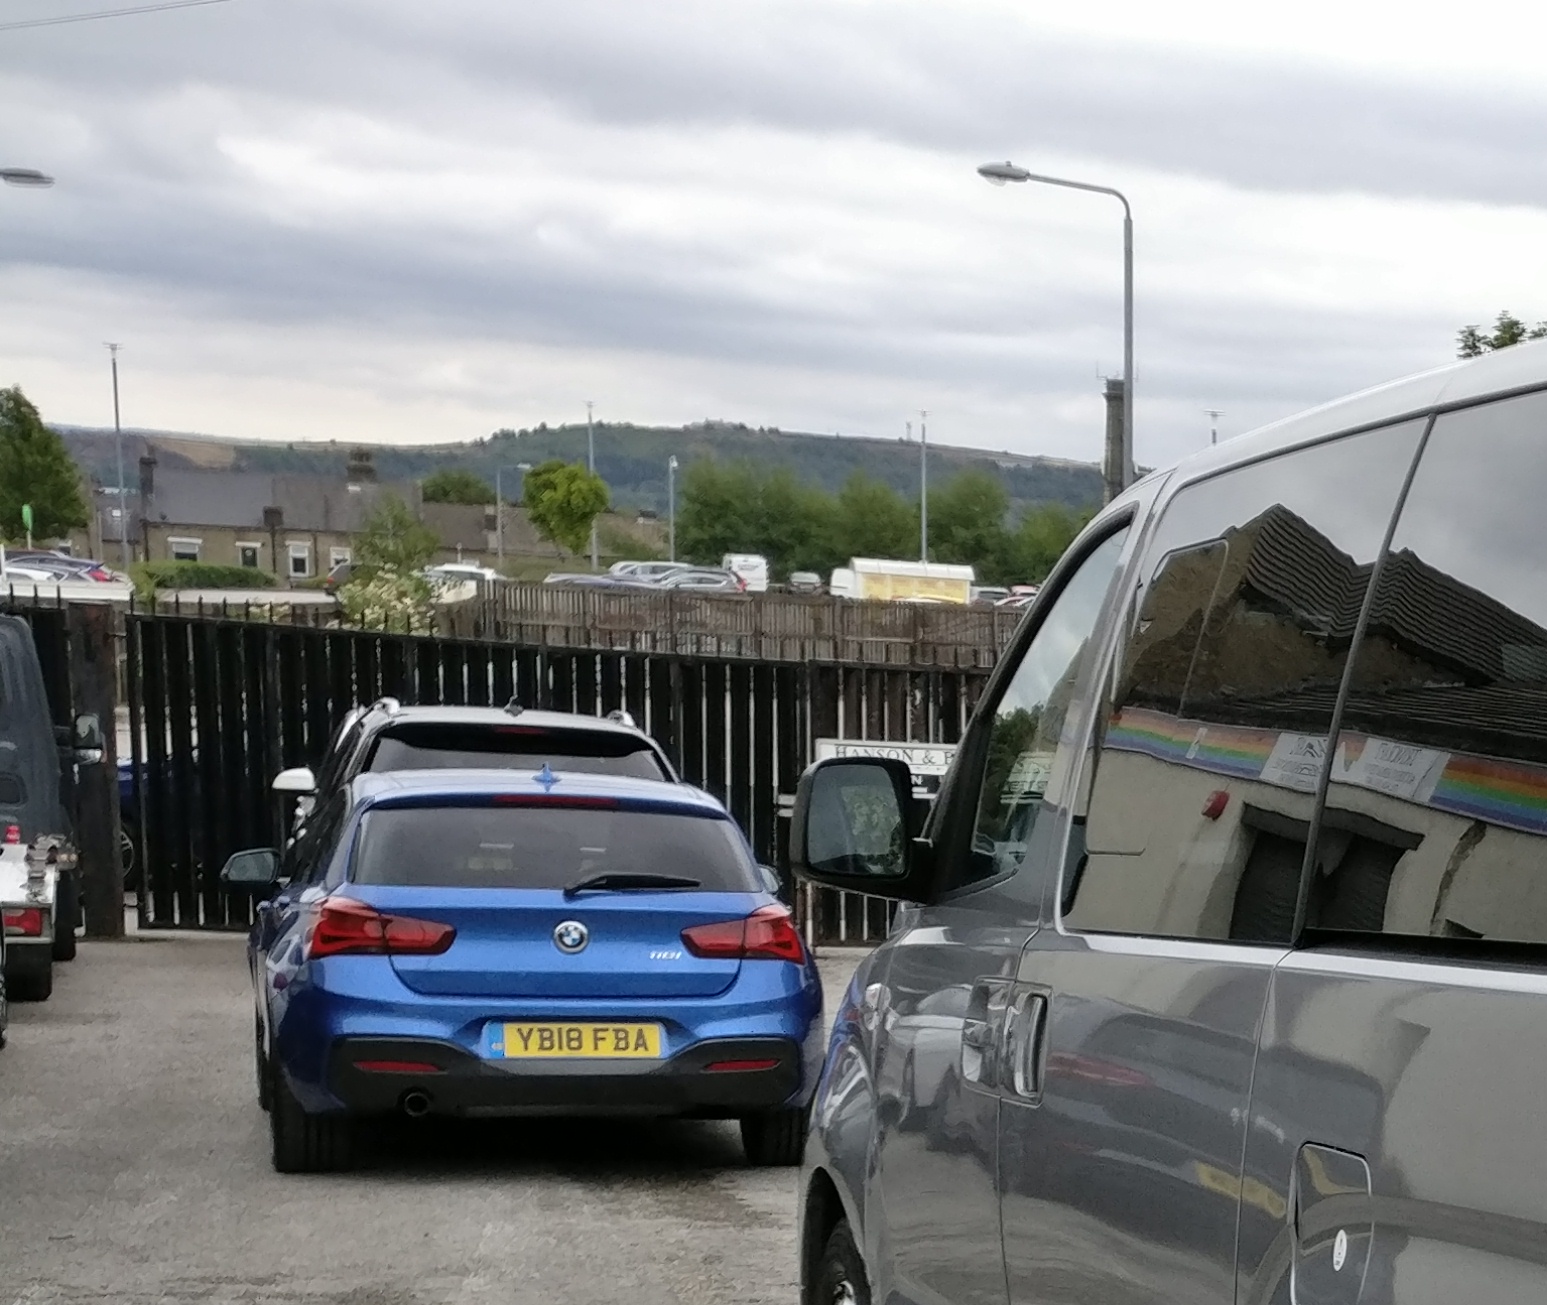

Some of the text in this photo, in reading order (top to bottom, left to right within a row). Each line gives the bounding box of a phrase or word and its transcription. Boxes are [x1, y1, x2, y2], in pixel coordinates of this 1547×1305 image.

[834, 746, 914, 763] HANSON
[922, 750, 937, 765] &
[516, 1027, 649, 1052] YB18 FBA
